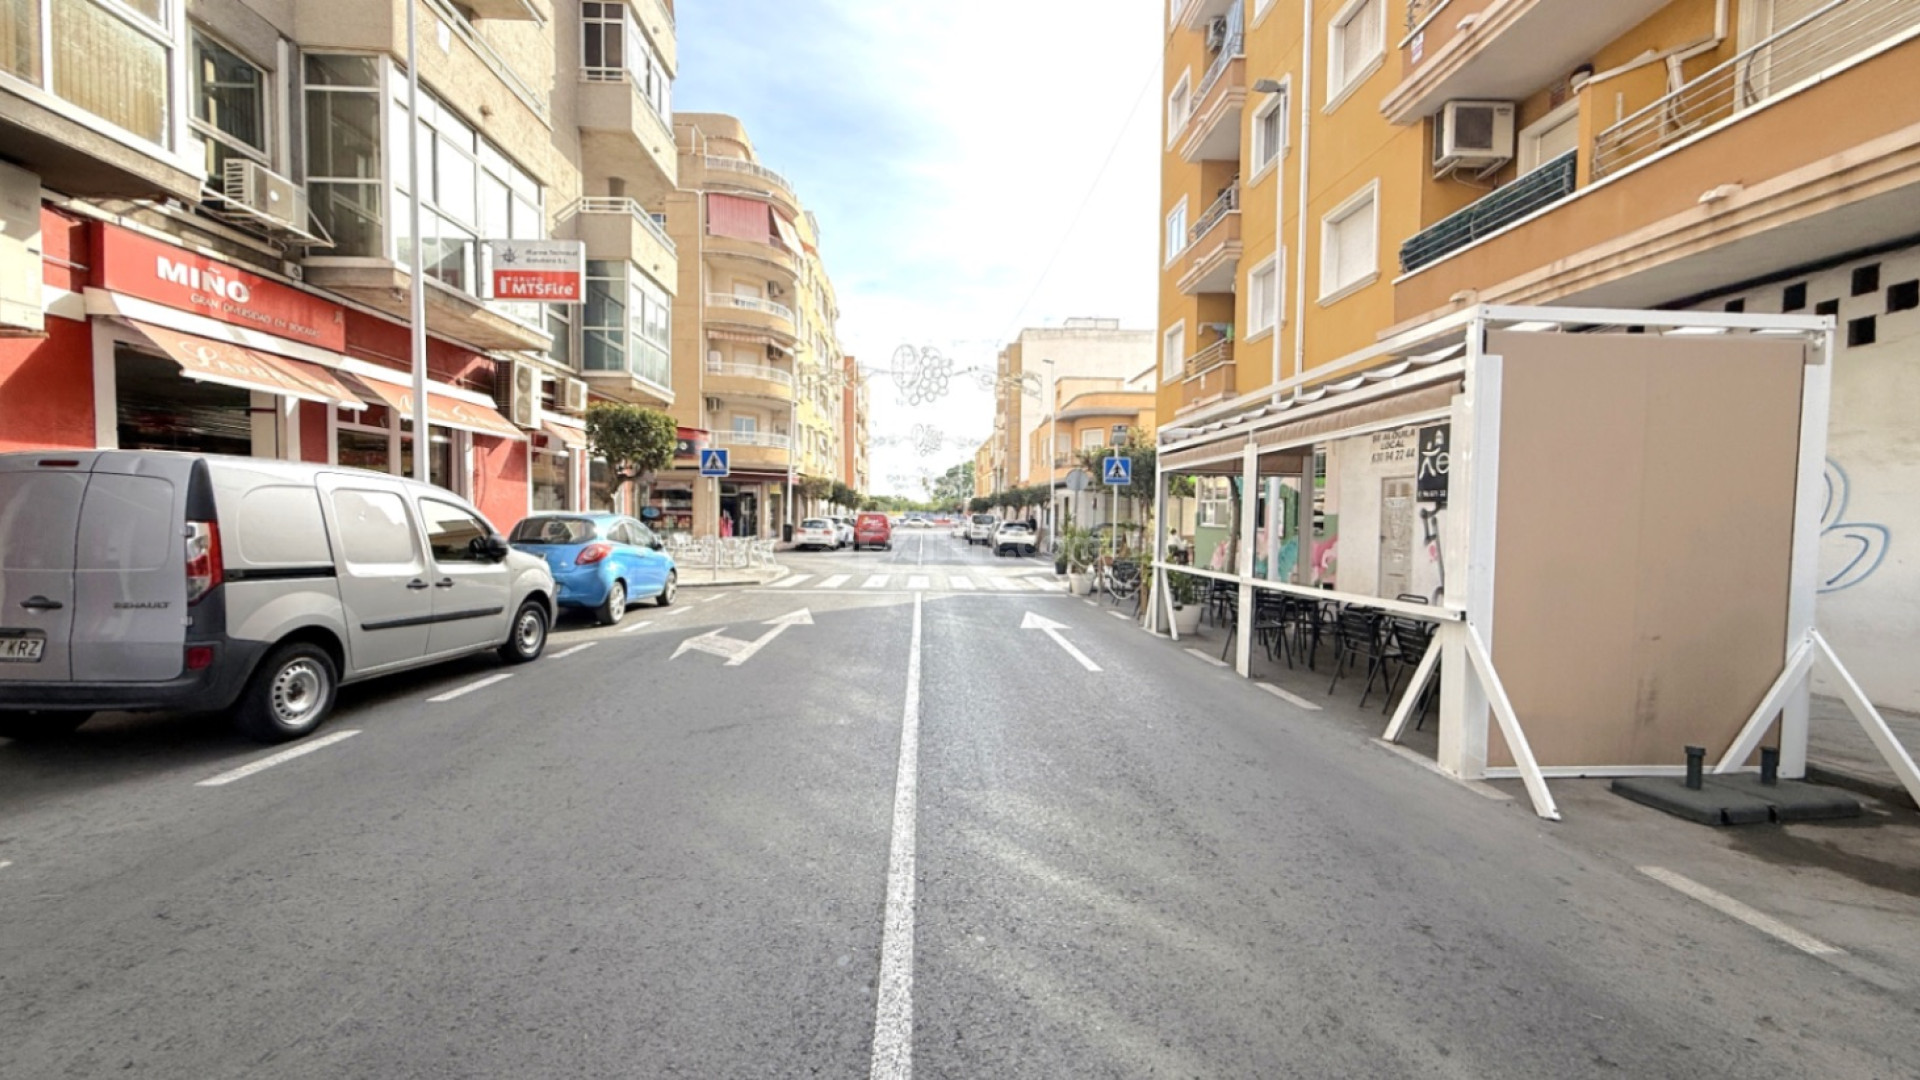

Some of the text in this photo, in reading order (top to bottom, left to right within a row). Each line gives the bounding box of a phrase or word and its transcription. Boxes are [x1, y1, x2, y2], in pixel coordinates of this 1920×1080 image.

[157, 256, 249, 303] MIÑO
[512, 283, 574, 295] MTSFire
[113, 601, 171, 609] RENAULT
[6, 640, 40, 657] KRZ
